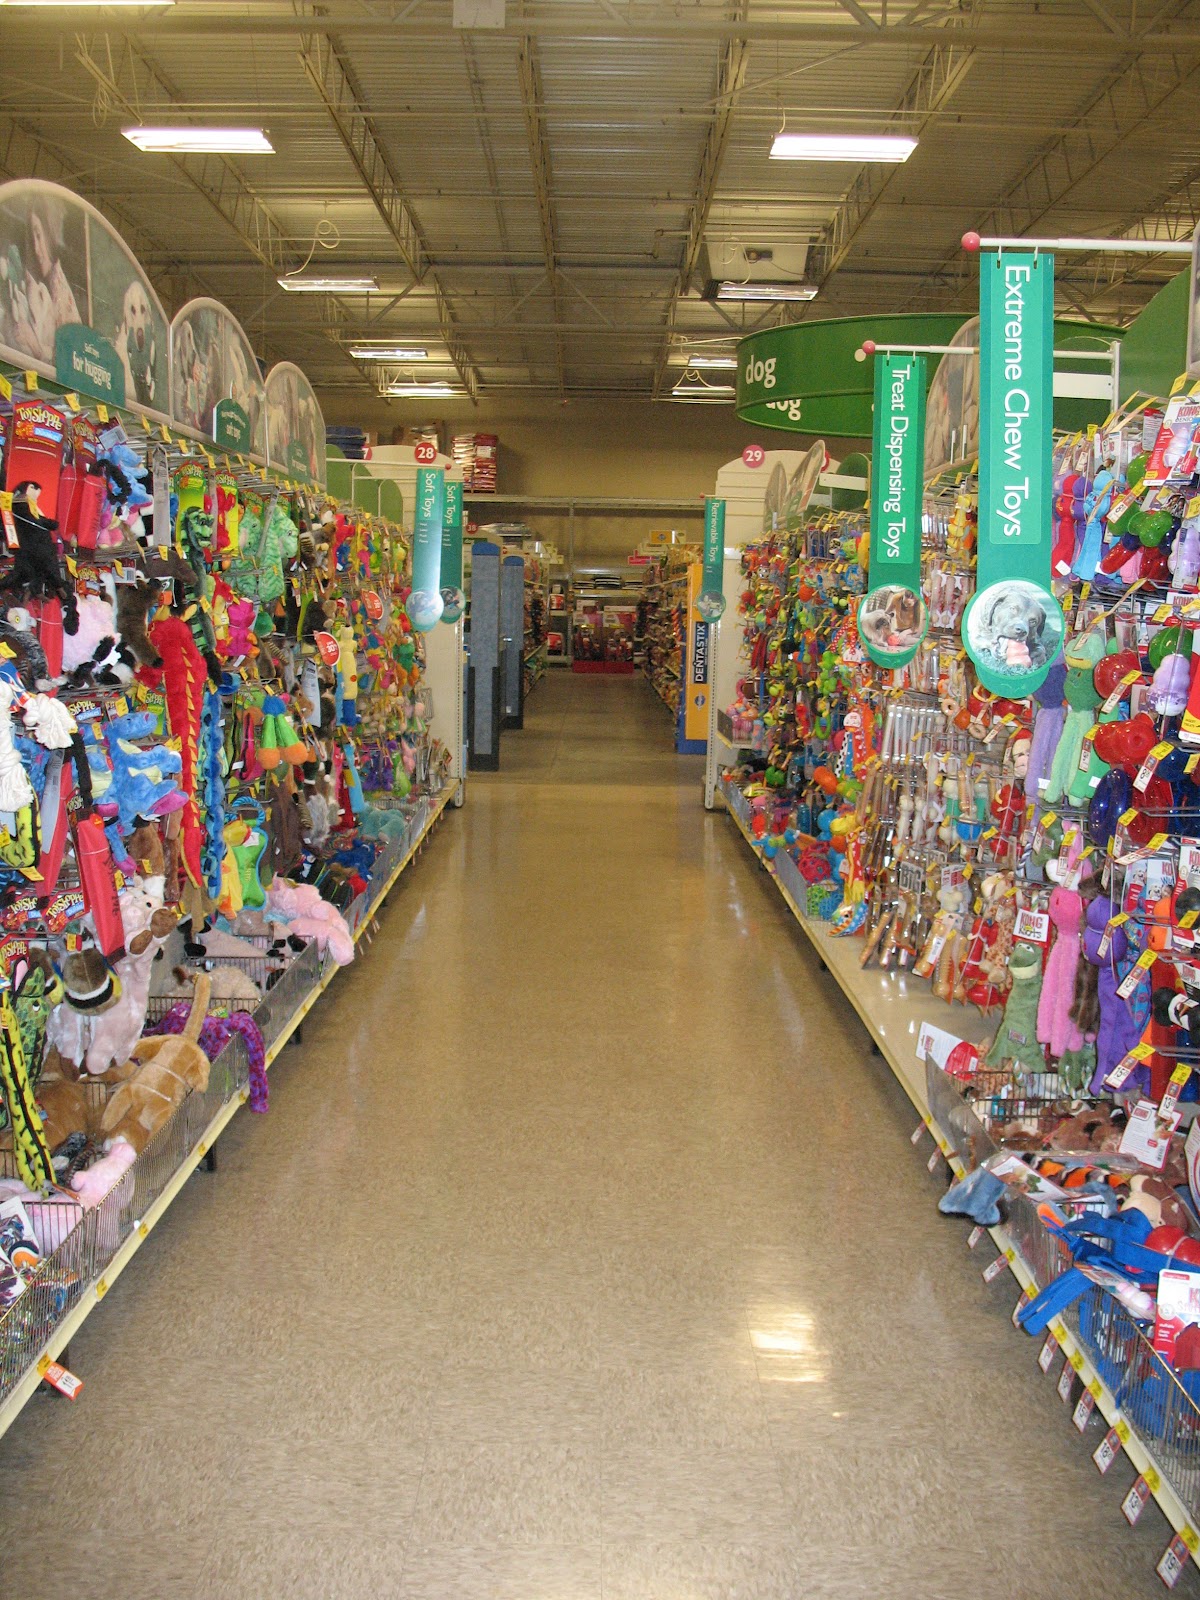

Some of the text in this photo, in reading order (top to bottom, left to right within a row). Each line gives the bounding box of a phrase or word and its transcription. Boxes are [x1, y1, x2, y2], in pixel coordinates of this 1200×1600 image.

[745, 354, 777, 389] dog
[996, 265, 1030, 537] Extreme Chew Toys
[417, 447, 434, 459] 28
[745, 450, 762, 463] 29
[882, 364, 910, 558] Treat Dispensing Toys
[421, 472, 436, 518] Soft Toys
[446, 485, 456, 503] Soft
[444, 505, 456, 525] Toys
[709, 502, 720, 563] Retrievable Toys
[694, 624, 706, 682] DENTASTIX
[1020, 912, 1044, 929] KONG
